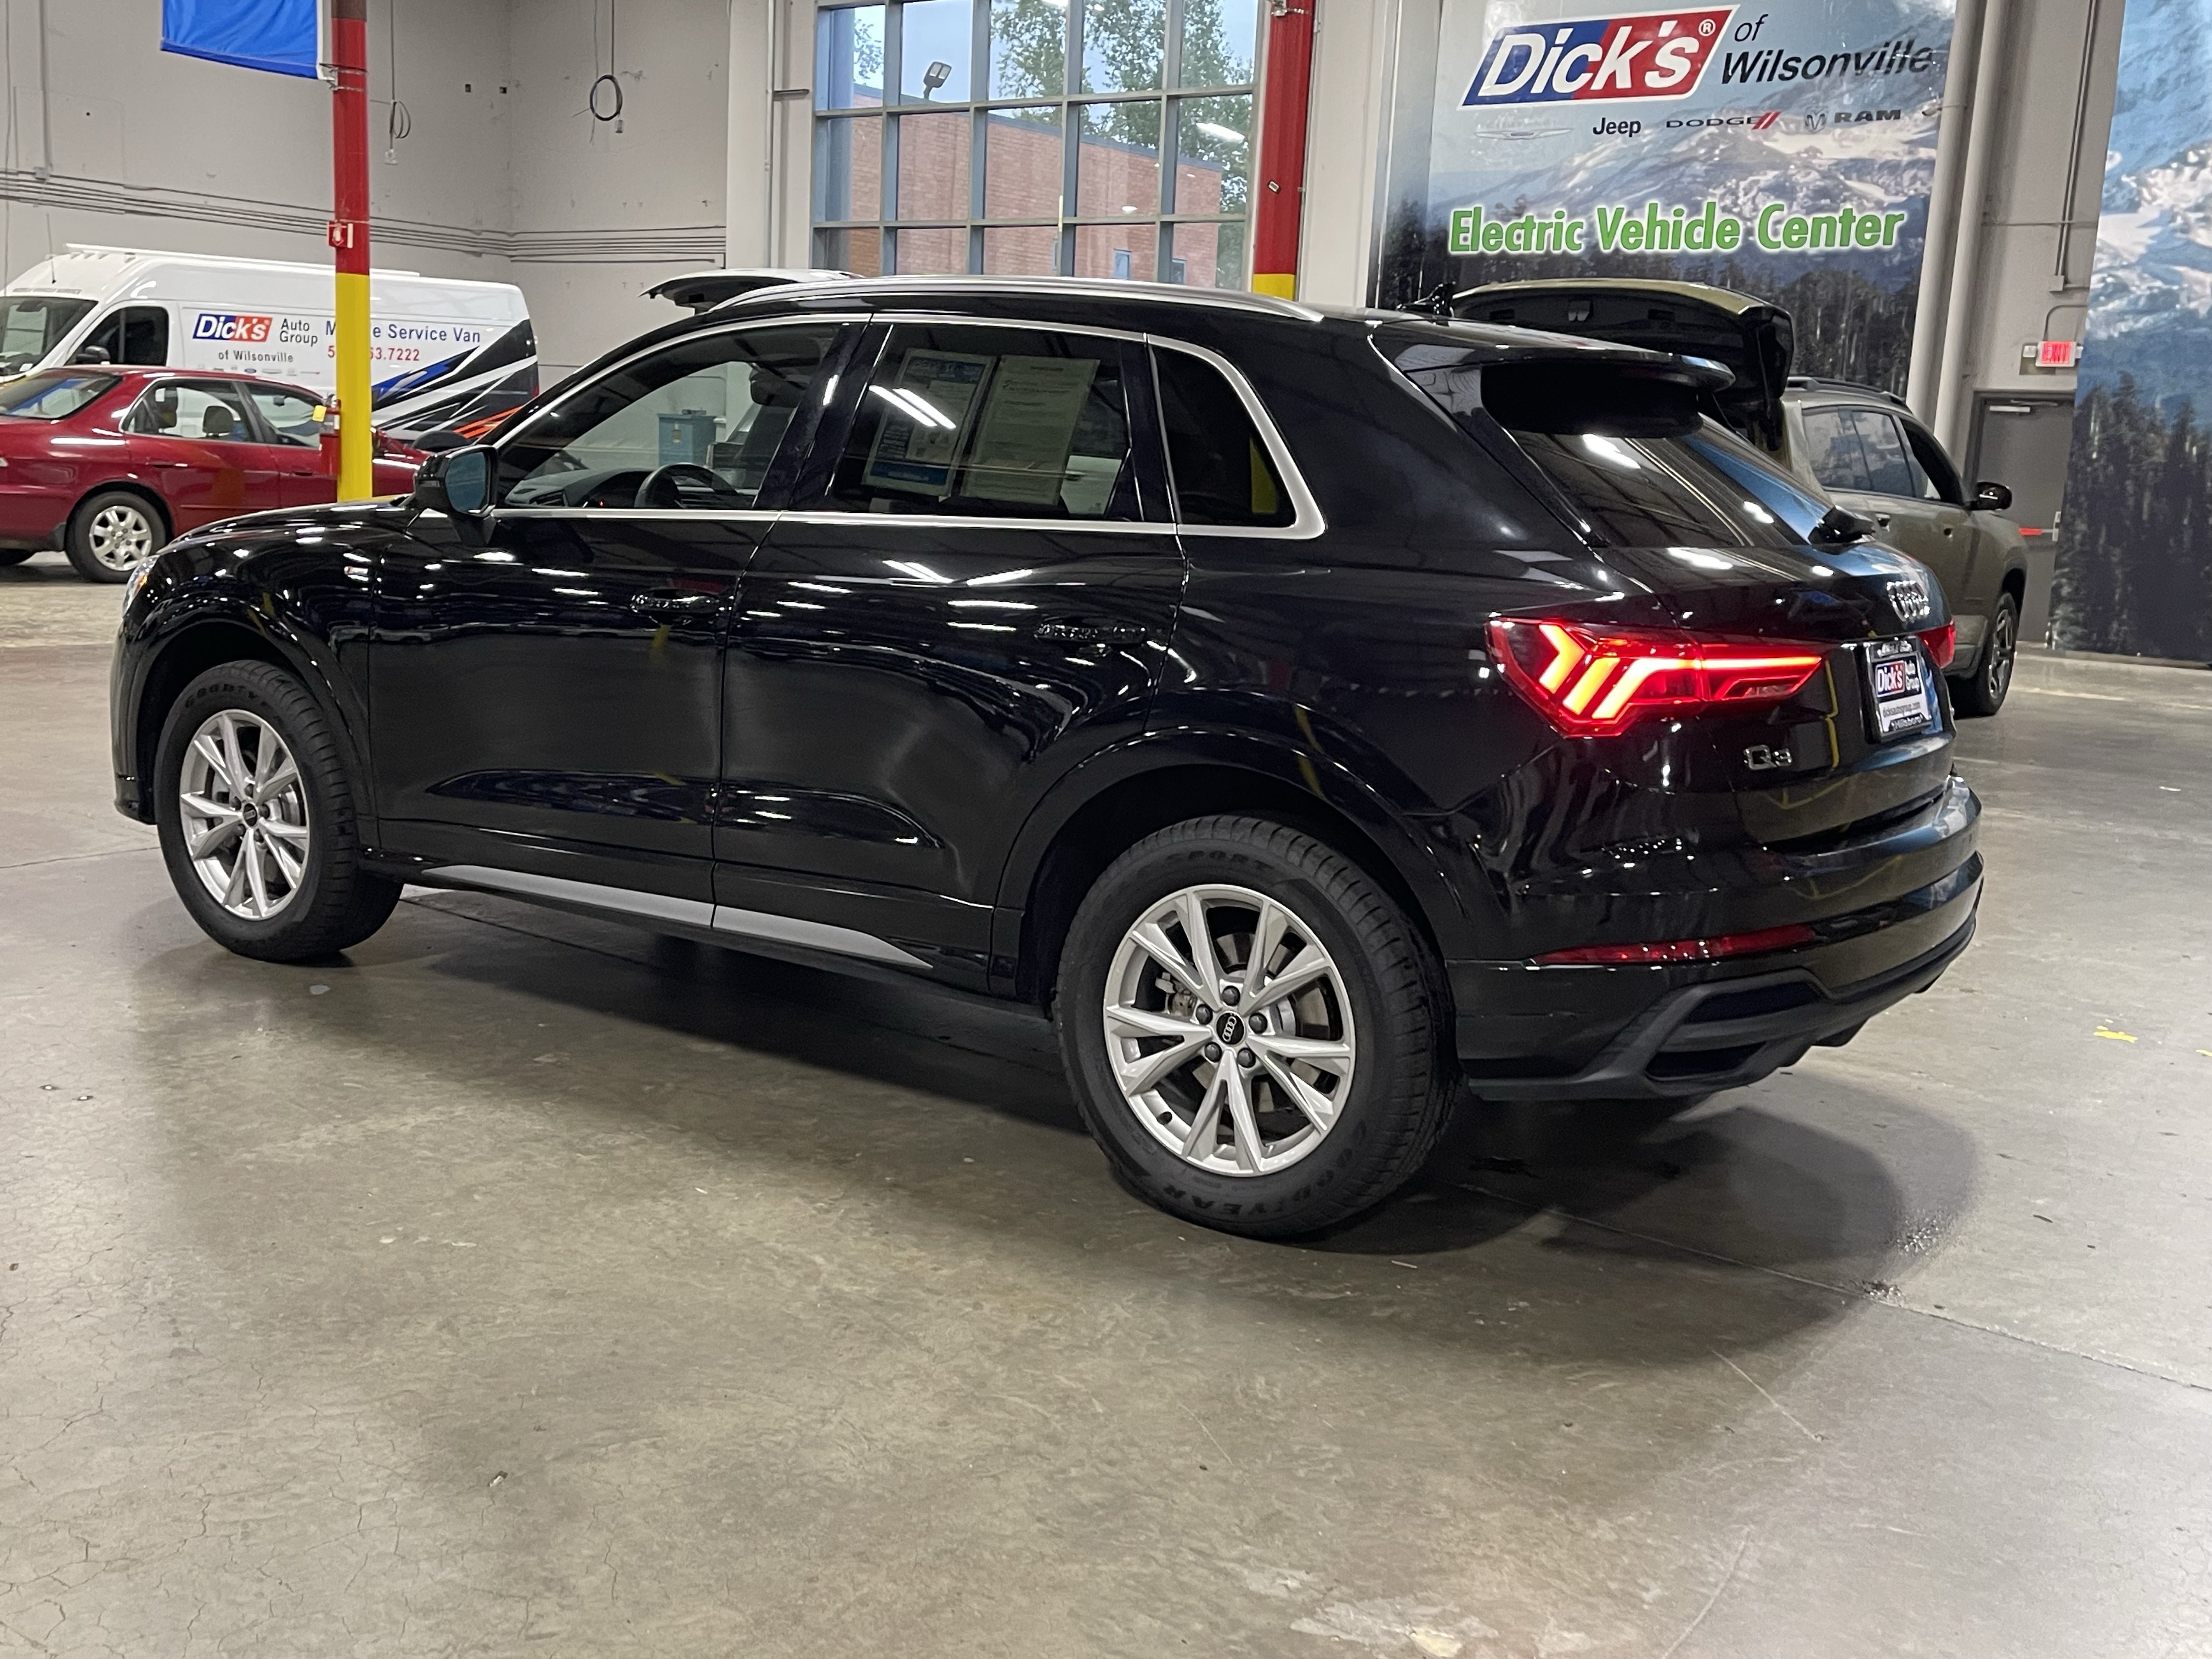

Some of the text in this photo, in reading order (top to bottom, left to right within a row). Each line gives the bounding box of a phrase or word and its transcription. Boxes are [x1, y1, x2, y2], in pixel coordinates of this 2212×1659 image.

[1477, 14, 1769, 97] Dick's of
[1721, 37, 1933, 86] Wilsonville
[1593, 117, 1641, 138] Jeep
[1666, 116, 1759, 129] DODGE
[1833, 109, 1901, 125] RAM
[1449, 201, 1905, 253] Electric Vehicle Center
[196, 316, 267, 340] Dick's
[280, 318, 310, 331] Auto
[279, 330, 318, 347] Group
[388, 324, 447, 341] Service
[453, 327, 480, 343] Van
[218, 349, 294, 363] of Wilsonville
[1877, 665, 1903, 692] Dick's
[1743, 744, 1793, 770] Q3
